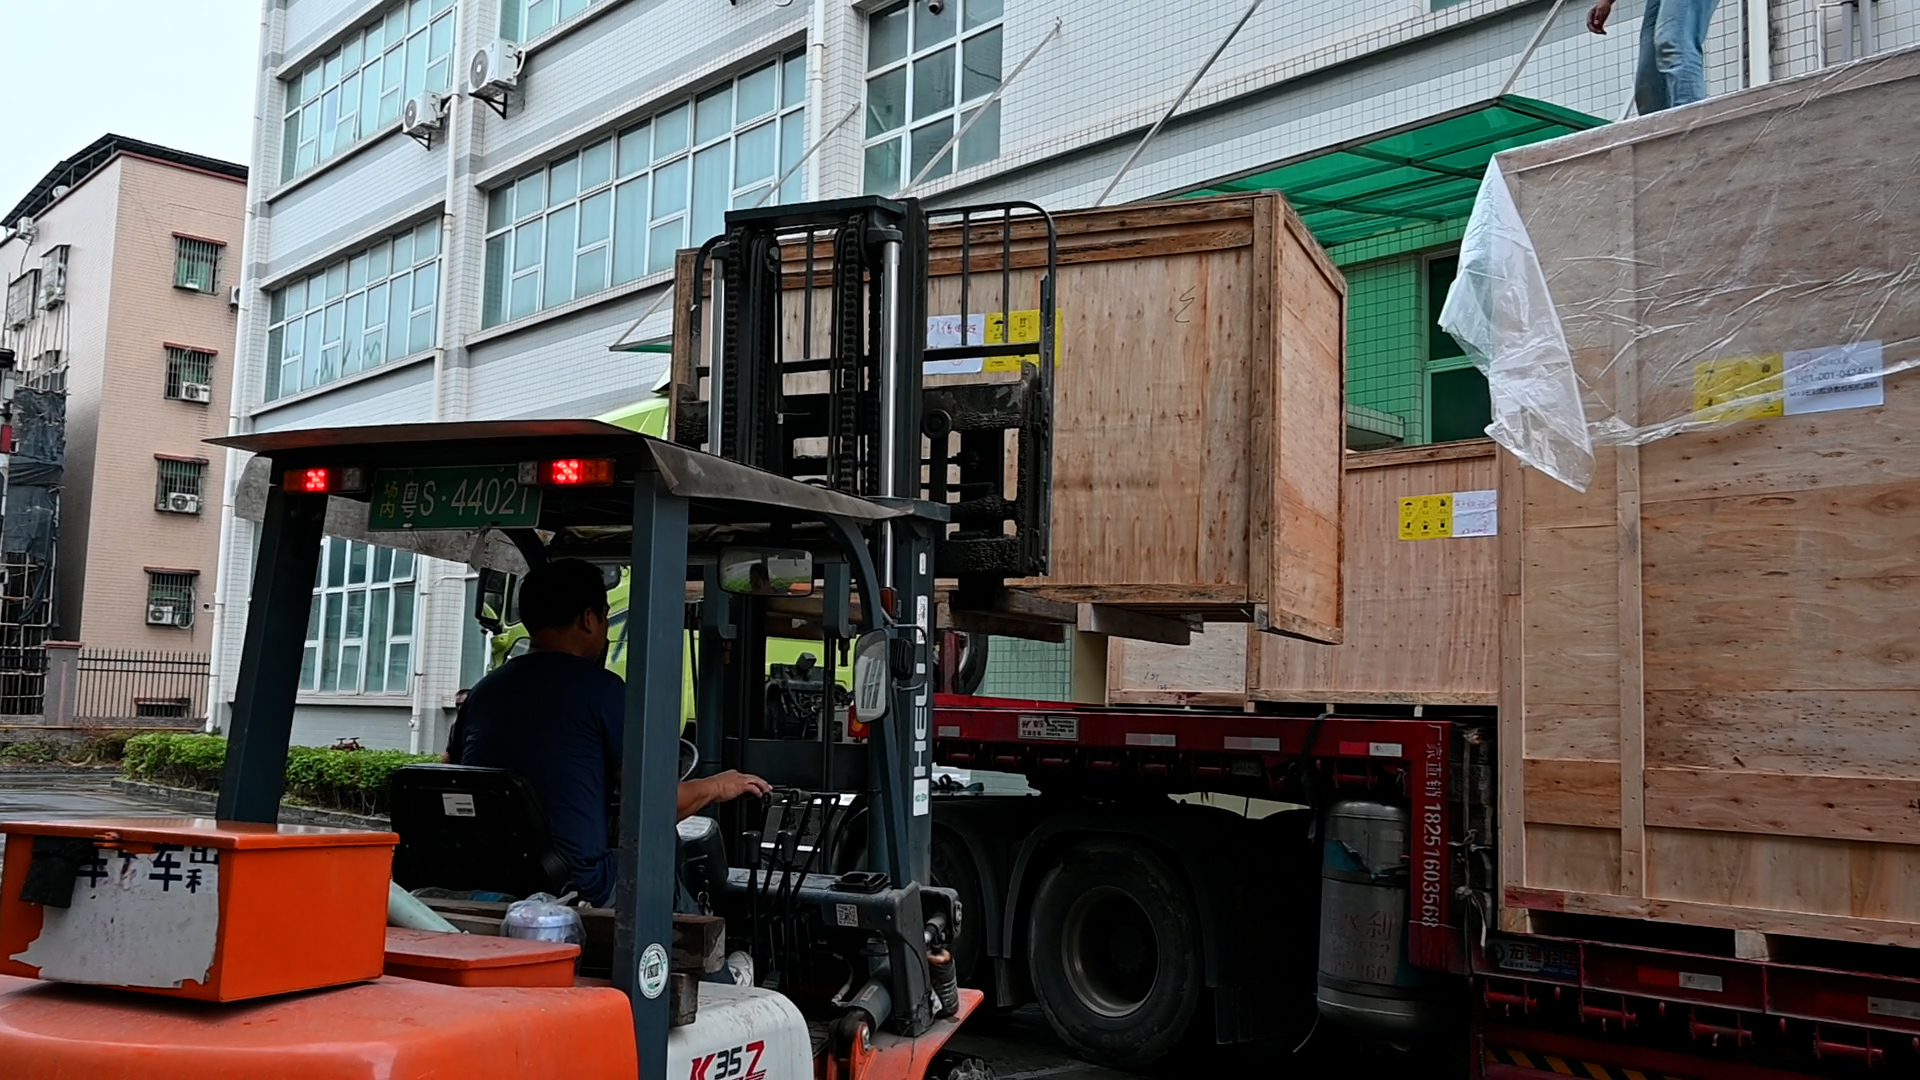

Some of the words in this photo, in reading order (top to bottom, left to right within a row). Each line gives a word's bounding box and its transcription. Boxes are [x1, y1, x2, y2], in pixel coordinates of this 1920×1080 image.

[380, 480, 399, 519] 场内
[1424, 723, 1444, 798] 厂家直销
